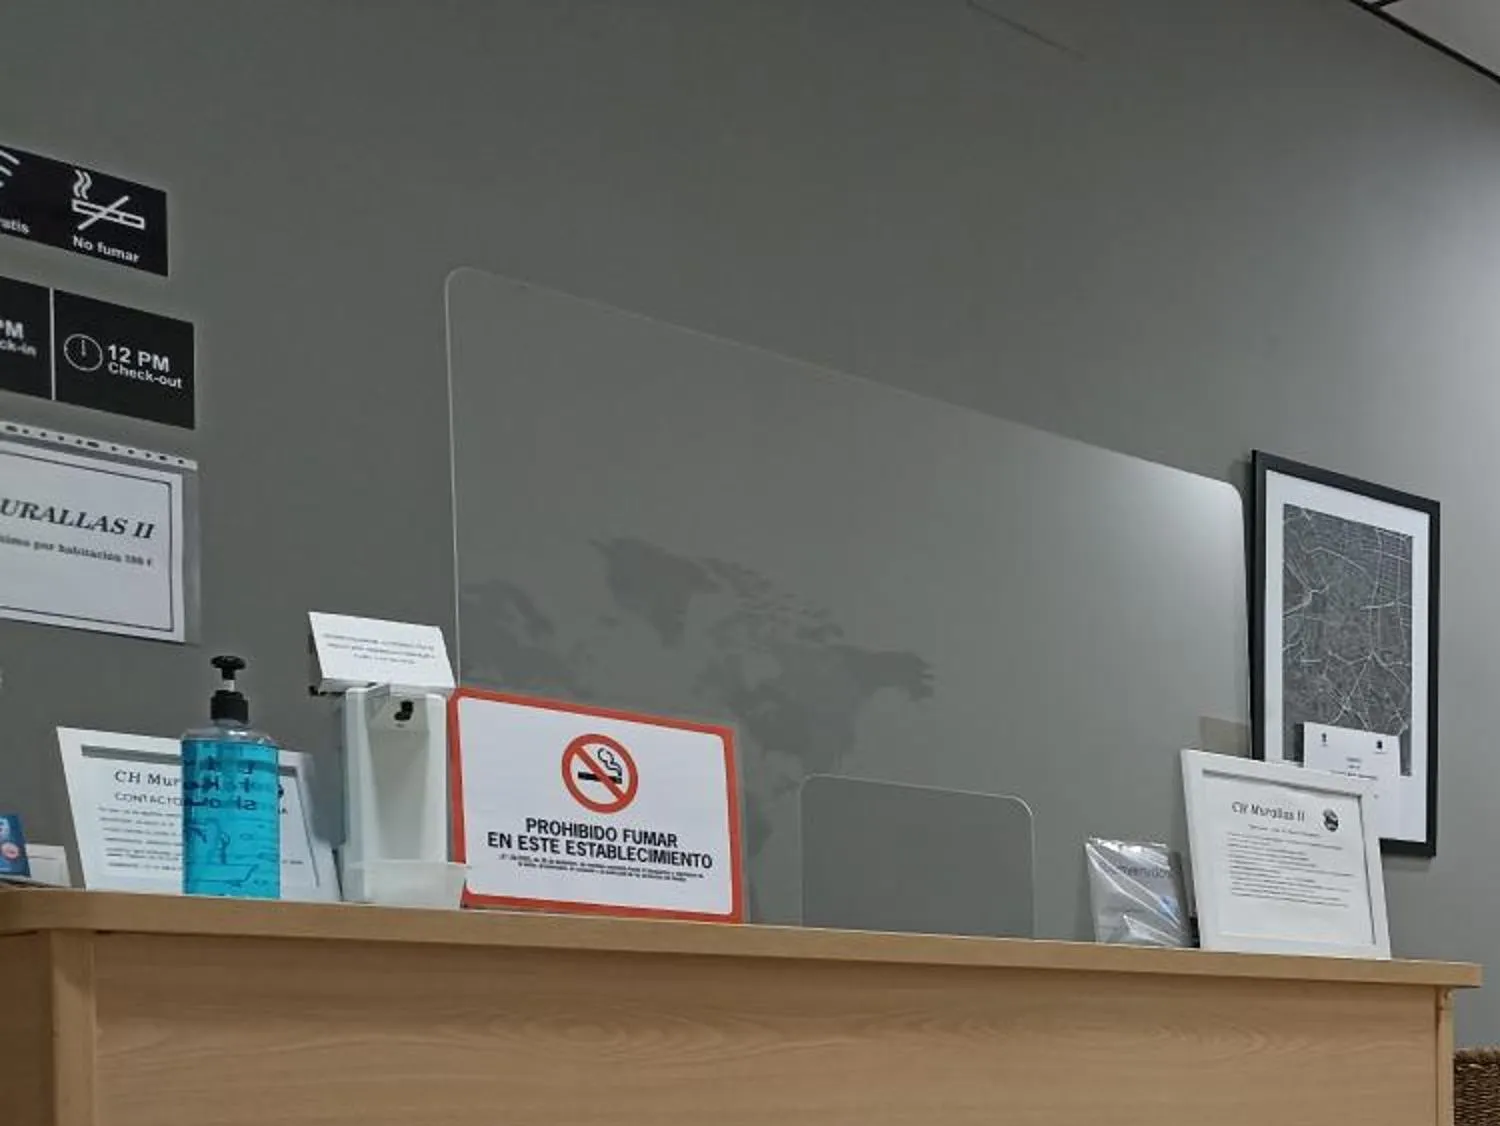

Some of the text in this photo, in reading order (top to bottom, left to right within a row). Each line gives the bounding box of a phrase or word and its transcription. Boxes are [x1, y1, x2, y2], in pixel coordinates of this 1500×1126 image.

[73, 235, 140, 263] No fumar
[108, 344, 170, 373] 12 PM
[108, 362, 183, 389] Check-out
[134, 520, 155, 539] II
[115, 769, 182, 787] CH Mur
[525, 818, 678, 848] PROHIBIDO FUMAR
[487, 831, 513, 849] EN
[518, 834, 560, 855] ESTE
[565, 840, 713, 869] ESTABLECIMIENTO
